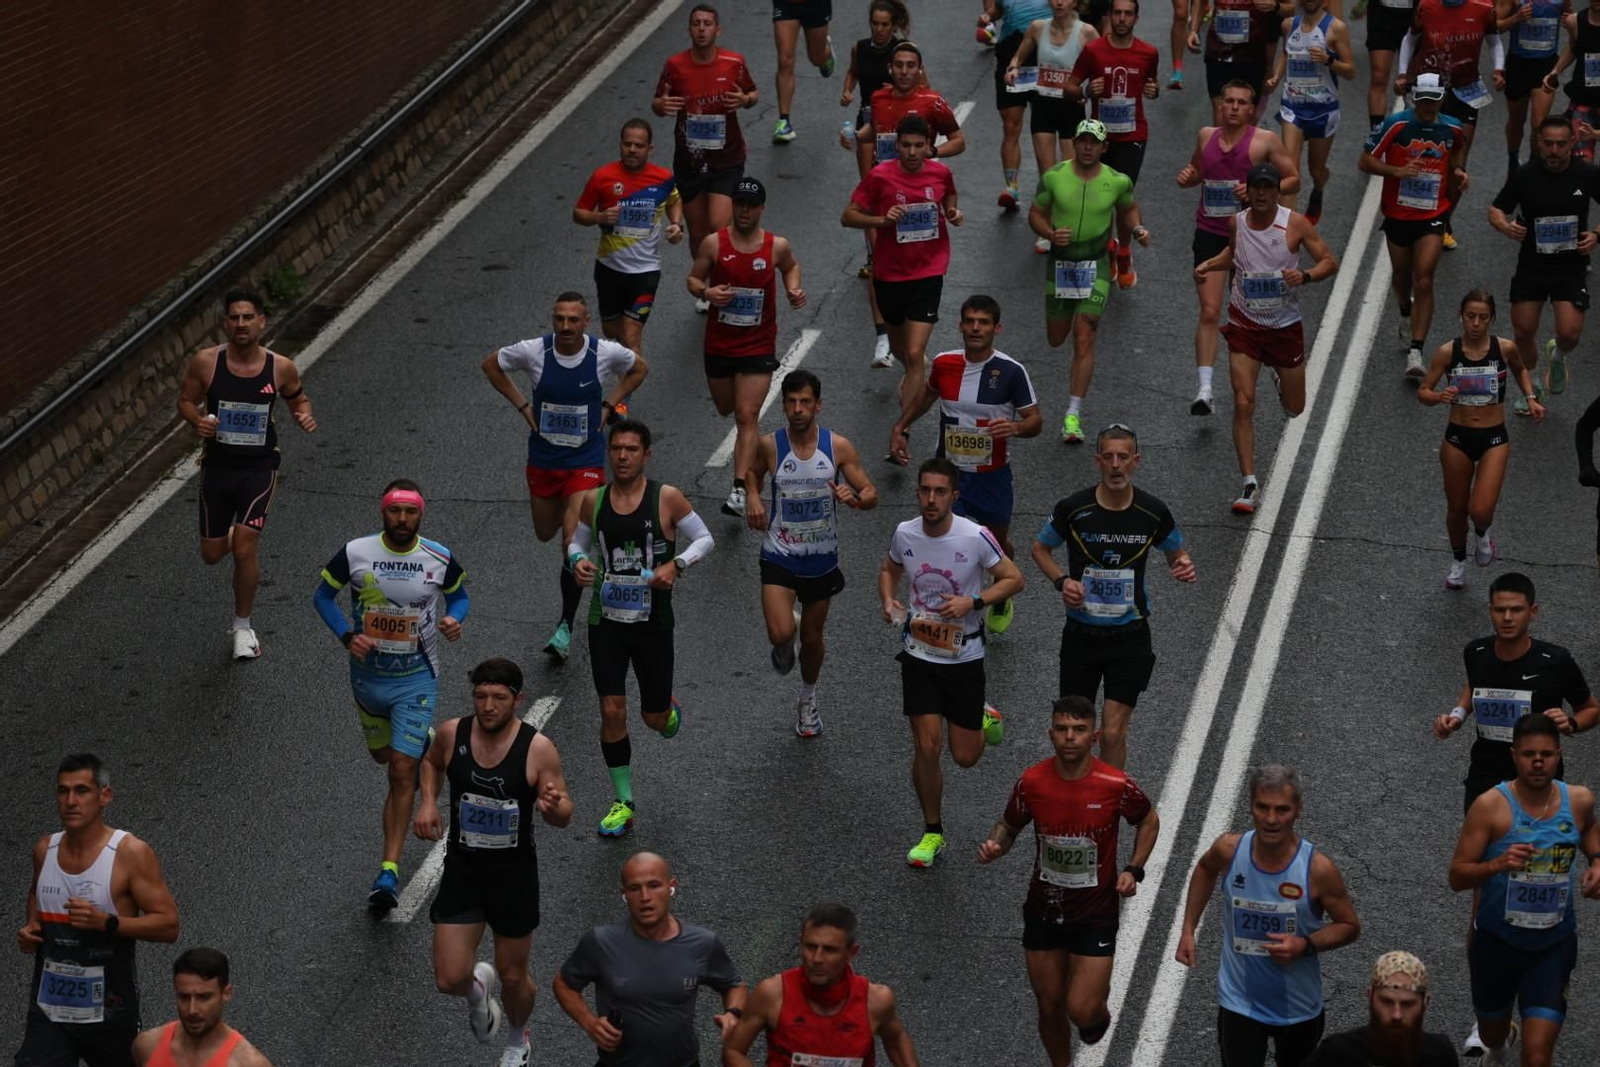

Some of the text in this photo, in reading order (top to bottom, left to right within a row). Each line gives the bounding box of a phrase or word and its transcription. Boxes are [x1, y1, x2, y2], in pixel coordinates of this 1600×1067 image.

[226, 412, 257, 428] 1552
[948, 434, 985, 449] 13698
[788, 501, 821, 516] 3072
[1080, 532, 1149, 545] FUNRUNNERS
[372, 561, 425, 573] FONTANA
[607, 586, 641, 603] 2065
[1090, 580, 1122, 597] 2955
[371, 617, 407, 634] 4005
[918, 623, 949, 642] 4141
[1481, 702, 1516, 719] 3241
[467, 807, 504, 828] 2211
[1046, 847, 1083, 866] 8022
[1517, 886, 1557, 904] 2847
[1241, 913, 1281, 932] 2759
[48, 977, 88, 999] 3225
